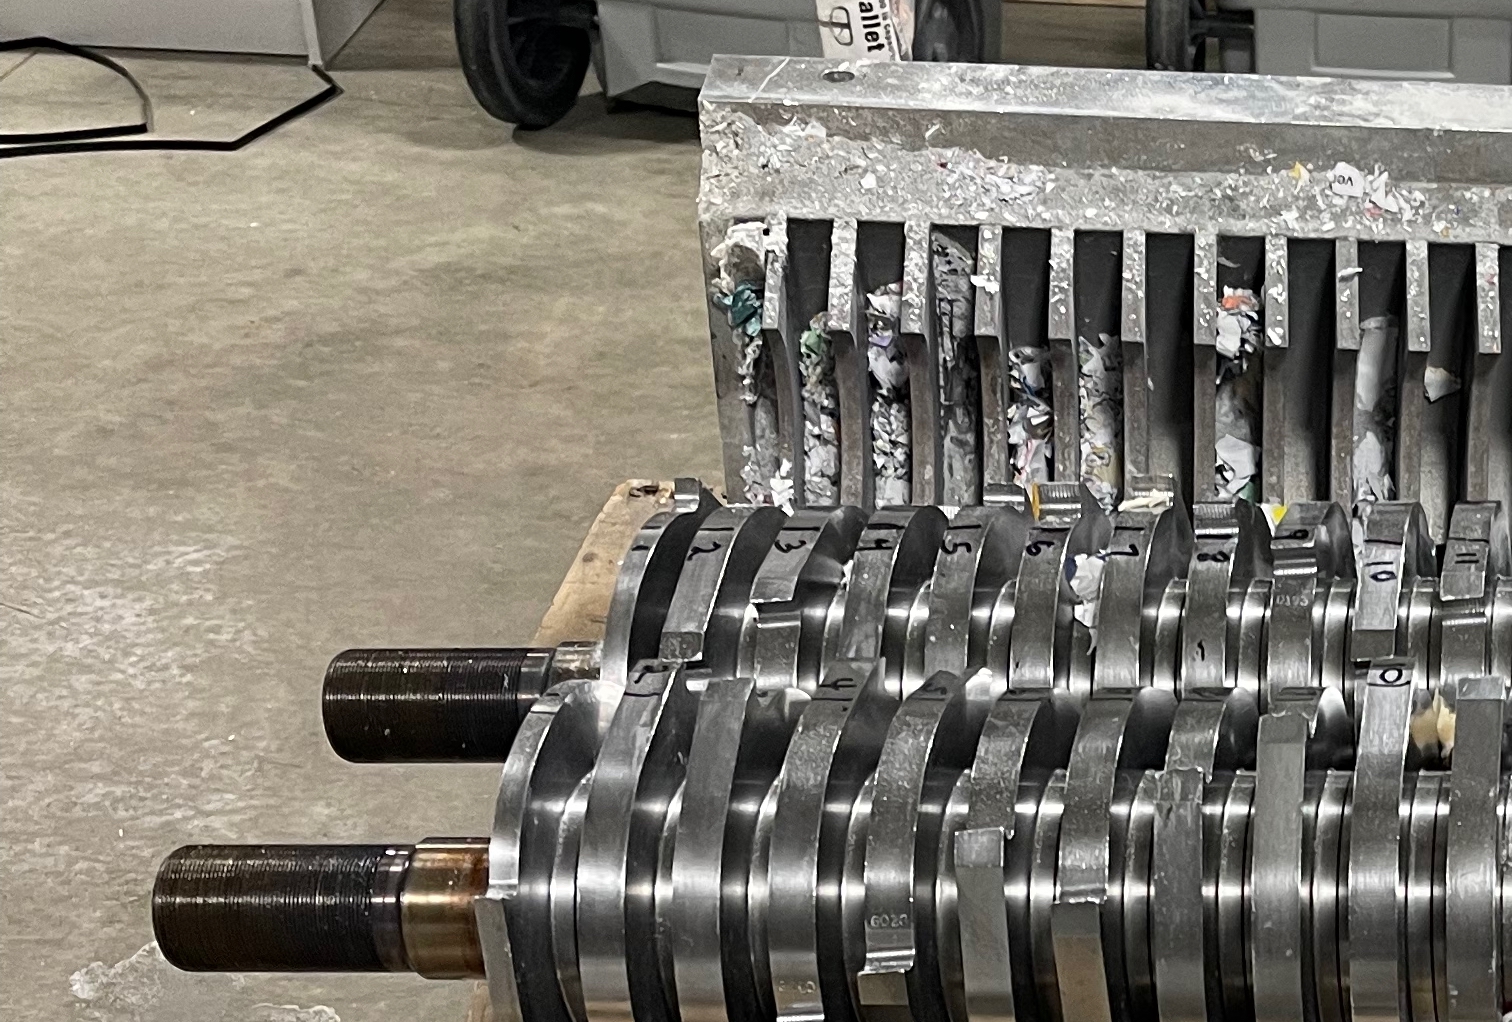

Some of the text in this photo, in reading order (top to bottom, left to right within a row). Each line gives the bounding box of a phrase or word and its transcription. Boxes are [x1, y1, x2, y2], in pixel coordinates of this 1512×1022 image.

[686, 541, 722, 561] 2
[774, 540, 807, 553] 3
[856, 538, 893, 551] 4
[941, 538, 972, 554] 5
[1026, 540, 1055, 556] 6
[1103, 543, 1140, 557] 7
[1455, 552, 1480, 565] 11
[1364, 560, 1397, 583] 10
